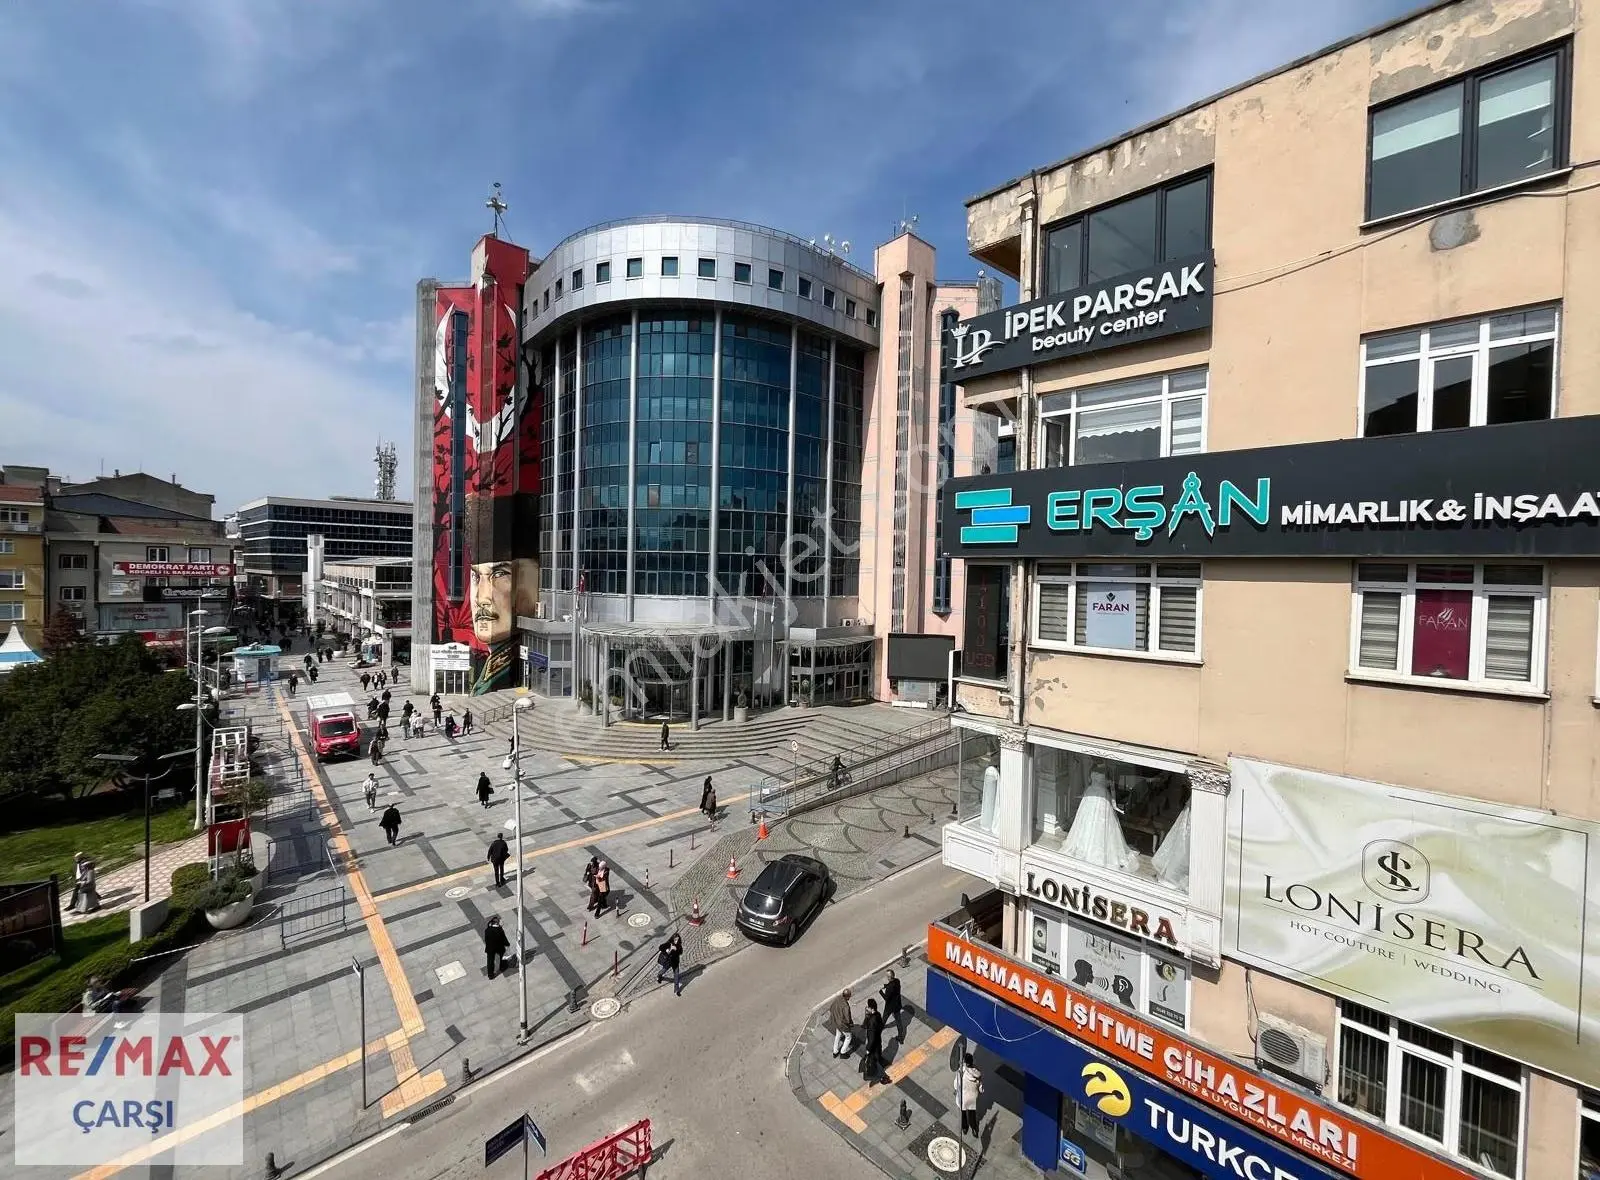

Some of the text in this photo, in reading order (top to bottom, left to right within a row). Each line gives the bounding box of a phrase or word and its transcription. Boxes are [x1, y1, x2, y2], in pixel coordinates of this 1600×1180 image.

[1004, 262, 1206, 340] İPEK PARSAK
[1032, 308, 1167, 352] beauty center
[1281, 499, 1434, 526] MİMARLIK
[1473, 492, 1600, 523] İNŞAA
[1092, 602, 1130, 612] FARAN
[1026, 871, 1178, 946] LONİSERA
[1263, 874, 1543, 981] LONİSERA
[1290, 920, 1503, 995] HOT COUTURE WEDDING
[945, 942, 1057, 1013] MARMARA
[1064, 992, 1154, 1061] İŞİTME
[1163, 1046, 1357, 1161] CİHAZLARI
[1165, 1071, 1198, 1093] SATIŞ
[1211, 1093, 1289, 1139] UYGULAMA
[1291, 1132, 1357, 1172] MERKEZİ
